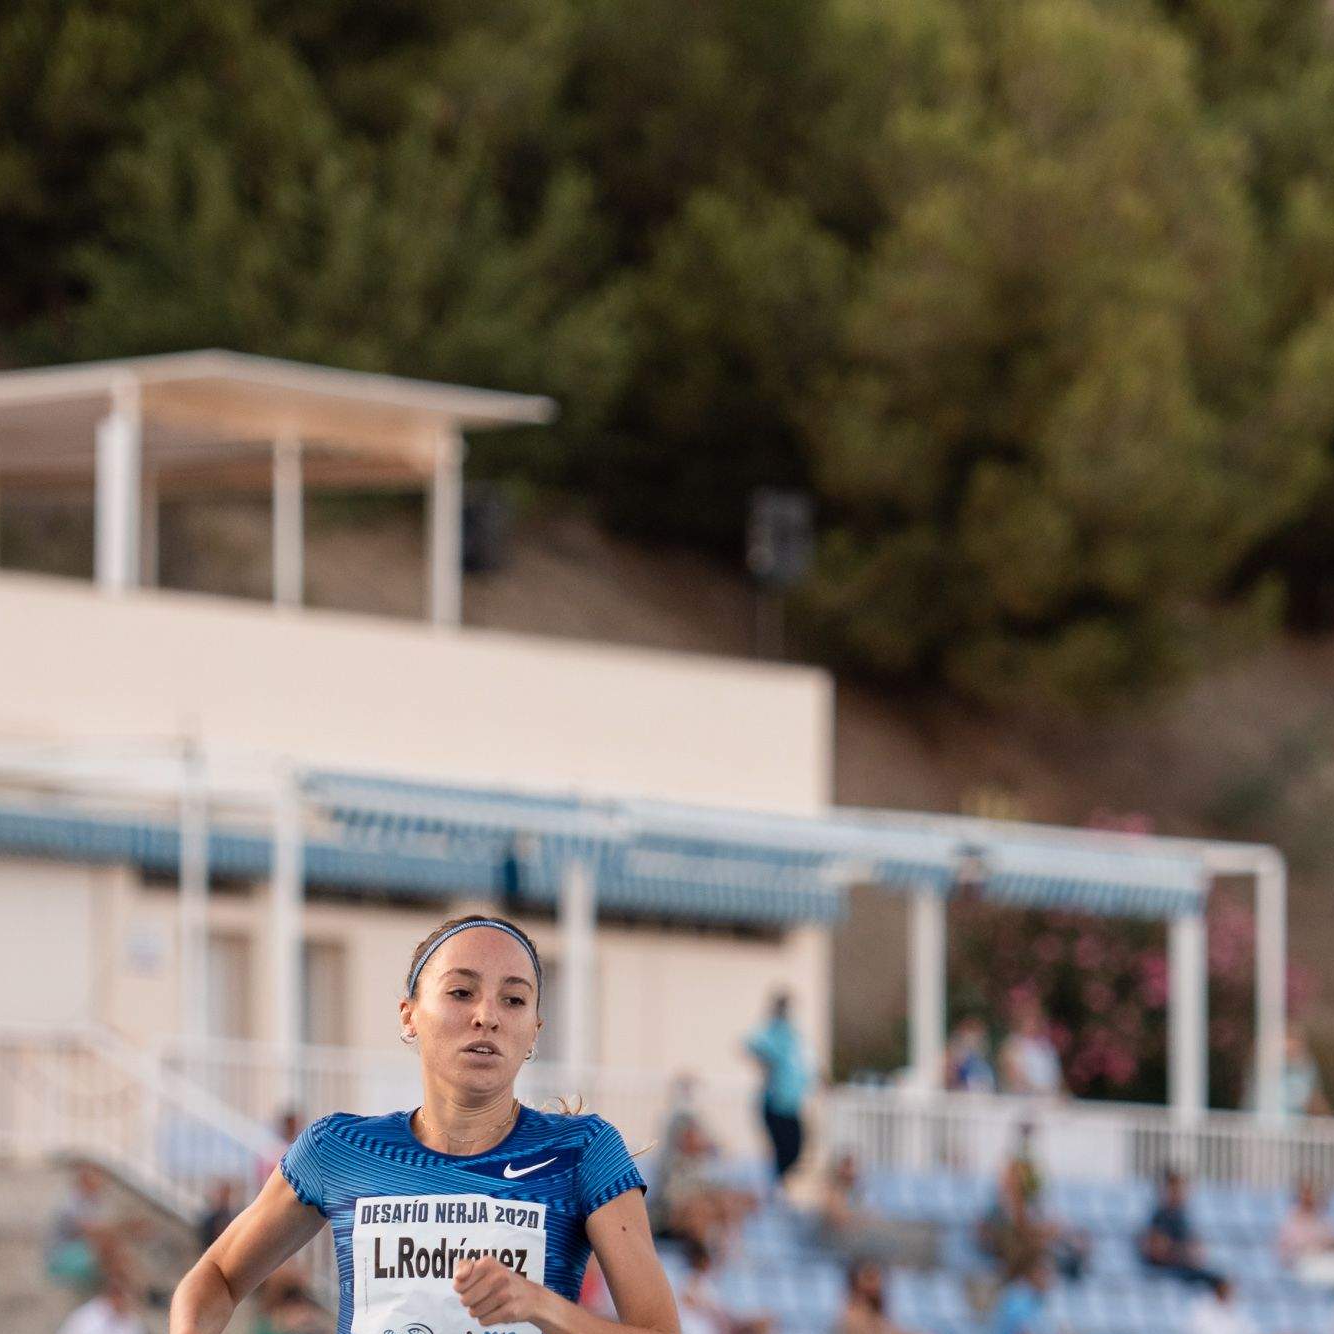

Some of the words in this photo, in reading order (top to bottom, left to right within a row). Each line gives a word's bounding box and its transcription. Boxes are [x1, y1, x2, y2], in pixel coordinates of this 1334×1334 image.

[360, 1200, 429, 1225] DESAFÍO
[435, 1202, 489, 1224] NERJA
[495, 1205, 540, 1229] 2020
